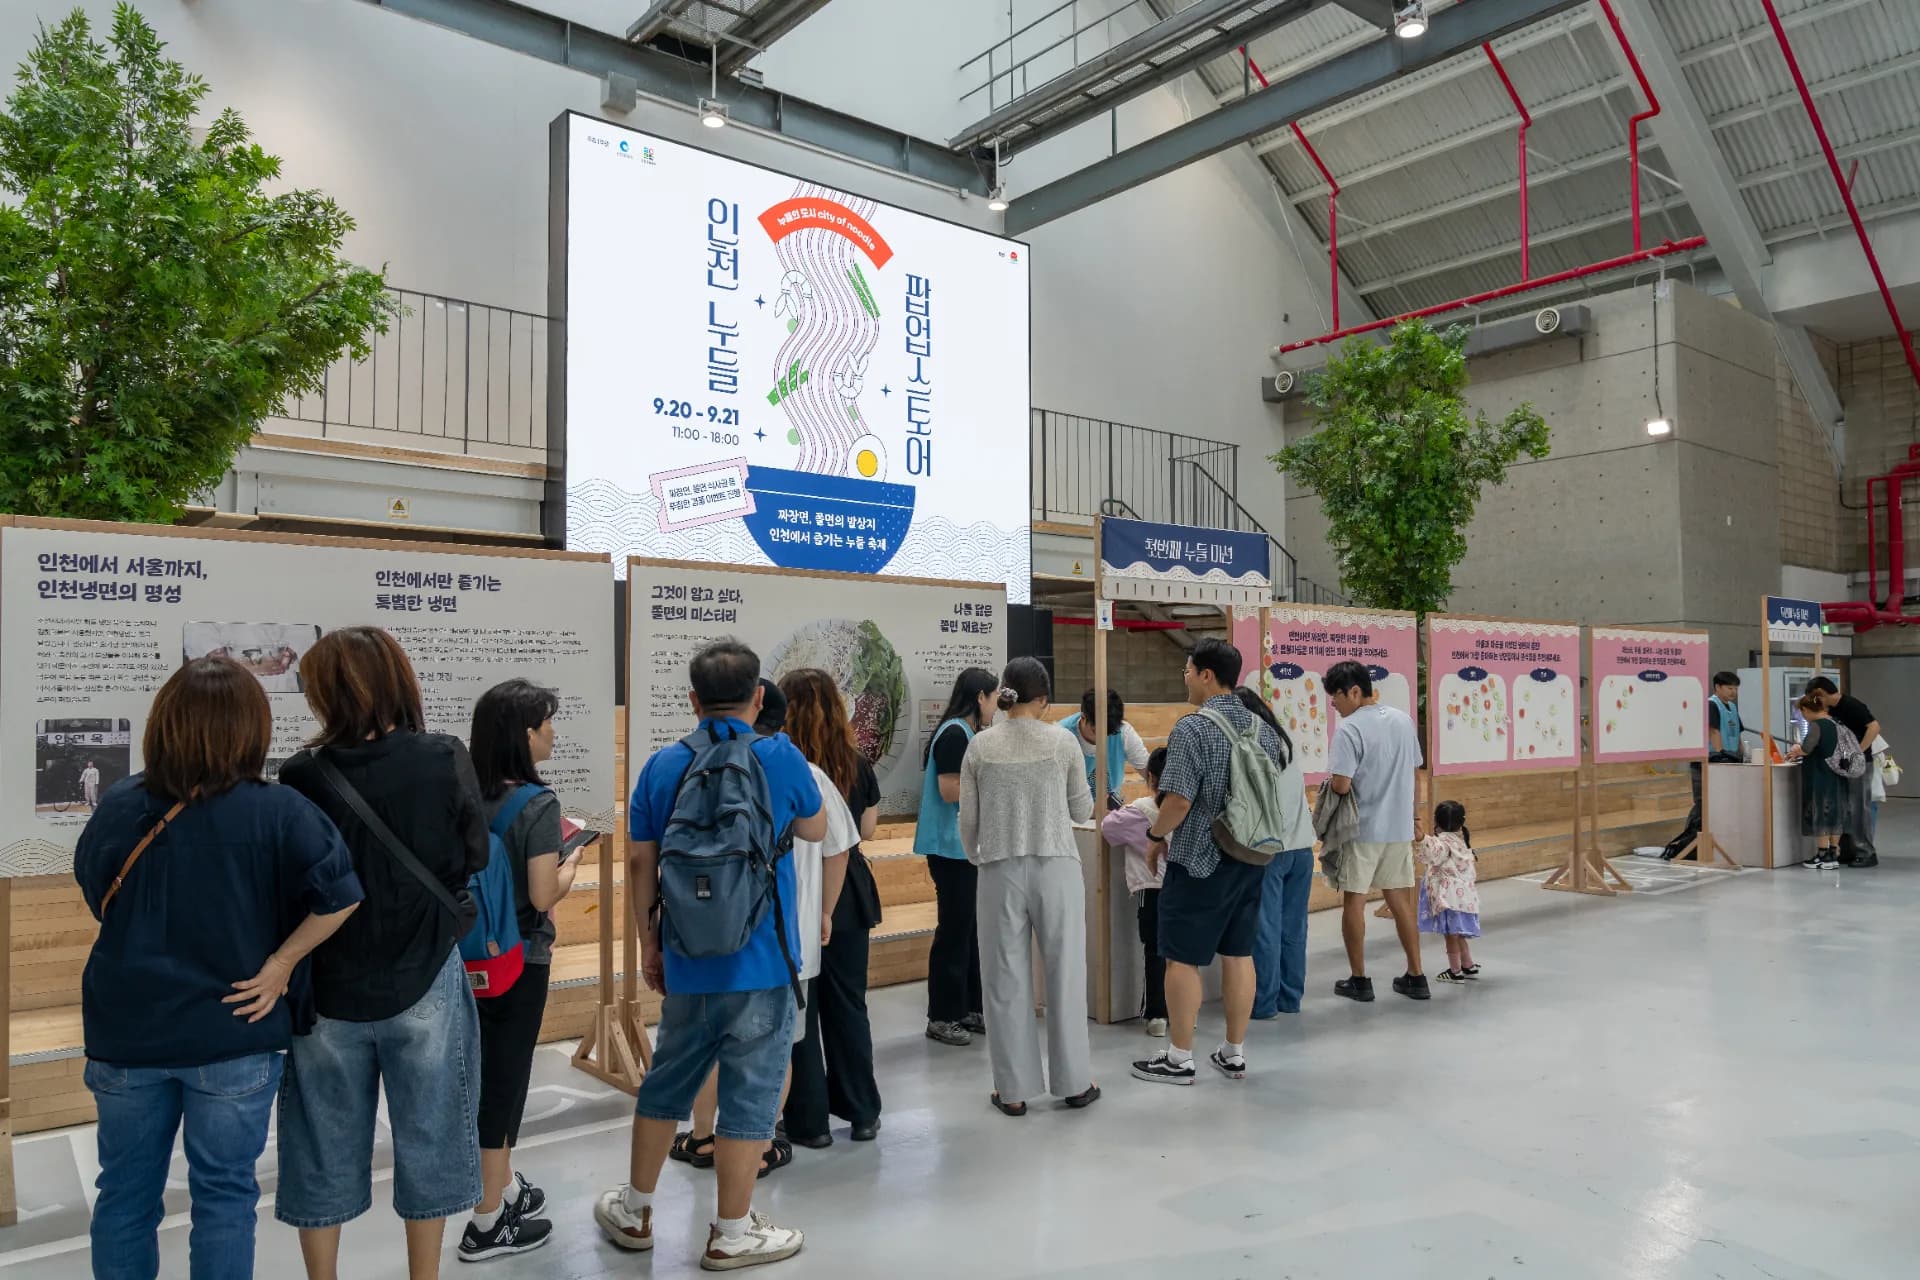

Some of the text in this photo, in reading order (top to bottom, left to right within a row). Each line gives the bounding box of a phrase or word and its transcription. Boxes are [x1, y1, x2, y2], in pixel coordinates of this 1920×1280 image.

[801, 208, 816, 219] 도시
[818, 210, 835, 222] city
[837, 217, 847, 226] of
[847, 222, 876, 251] noodle
[707, 198, 739, 395] 인천 누들
[905, 273, 932, 477] 팝업스토어
[653, 397, 692, 418] 9.20
[708, 406, 739, 425] 9.21
[672, 426, 700, 440] 11:00
[711, 431, 740, 446] 18:00
[706, 491, 727, 503] 이벤트
[815, 512, 844, 528] 쫄면의
[847, 516, 876, 531] 발상지
[769, 528, 887, 551] 인천에서 즐기는 누들 축제
[1145, 538, 1233, 565] 첫번째 누들 미션
[37, 552, 208, 581] 인천에서 서울까지,
[37, 579, 182, 603] 인천냉면의 명성
[375, 570, 502, 592] 인천에서만 즐기는
[375, 594, 457, 612] 특별한 냉면
[651, 585, 743, 605] 그것이 알고 싶다,
[651, 604, 737, 623] 쫄면의 미스터리
[961, 620, 993, 634] 재료는?
